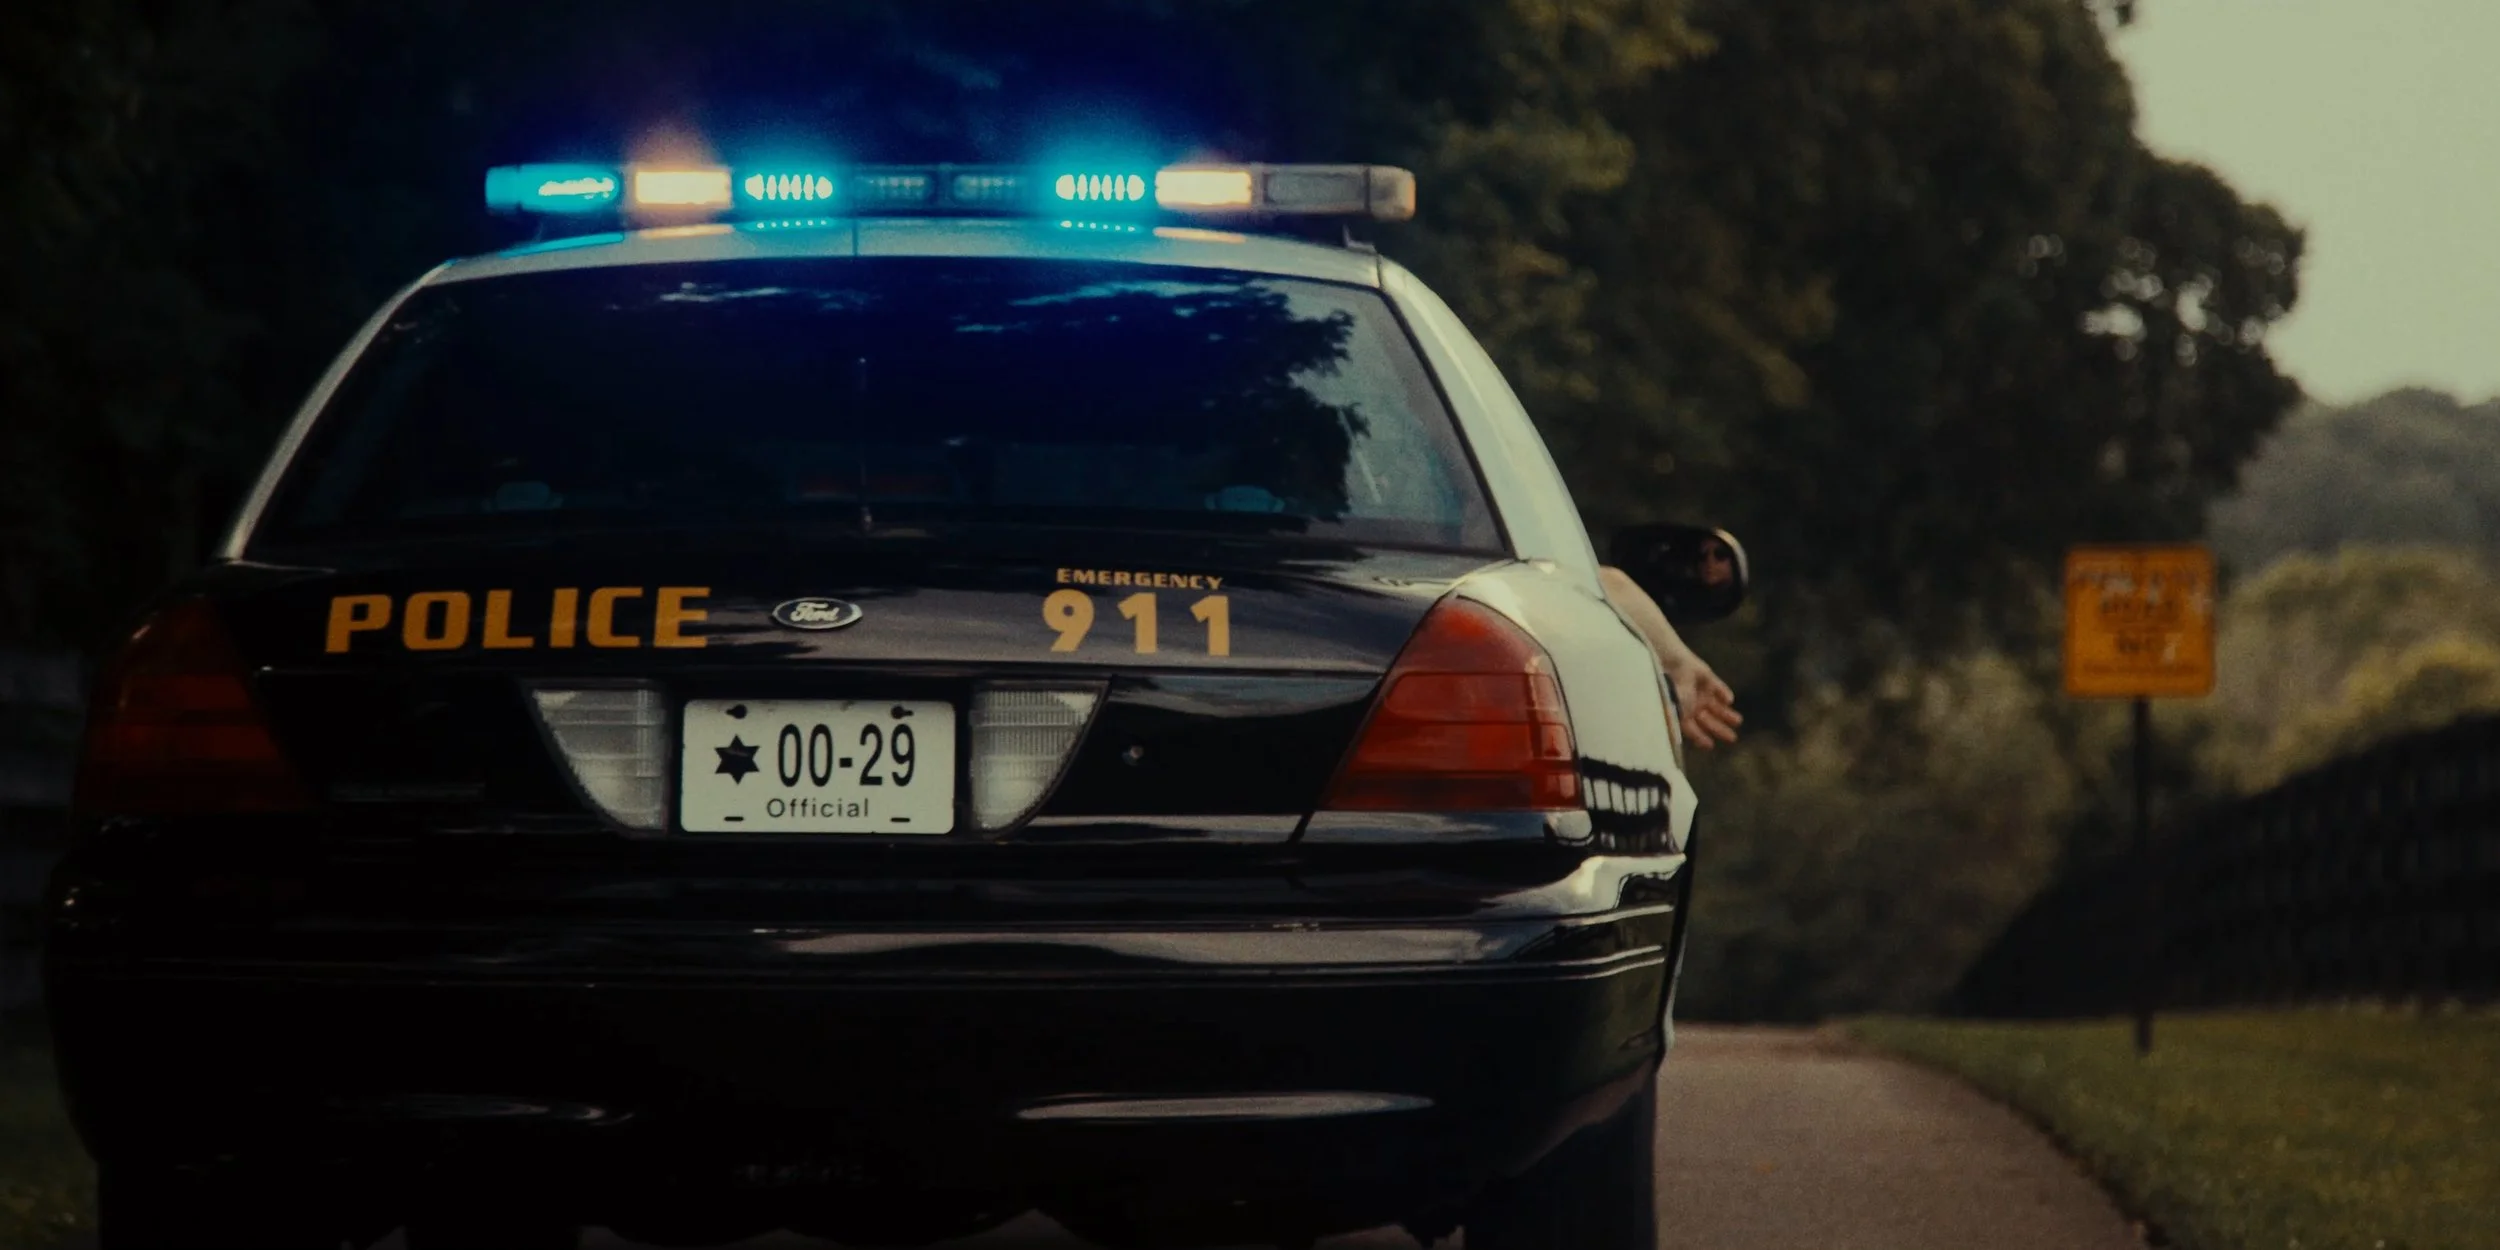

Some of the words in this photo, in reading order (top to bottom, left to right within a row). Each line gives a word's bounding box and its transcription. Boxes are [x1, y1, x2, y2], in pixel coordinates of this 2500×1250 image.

[1056, 568, 1223, 589] EMERGENCY
[325, 587, 711, 653] POLICE
[790, 602, 840, 621] Ford
[1042, 588, 1230, 657] 911
[777, 723, 915, 787] 00-29
[766, 798, 869, 818] Official
